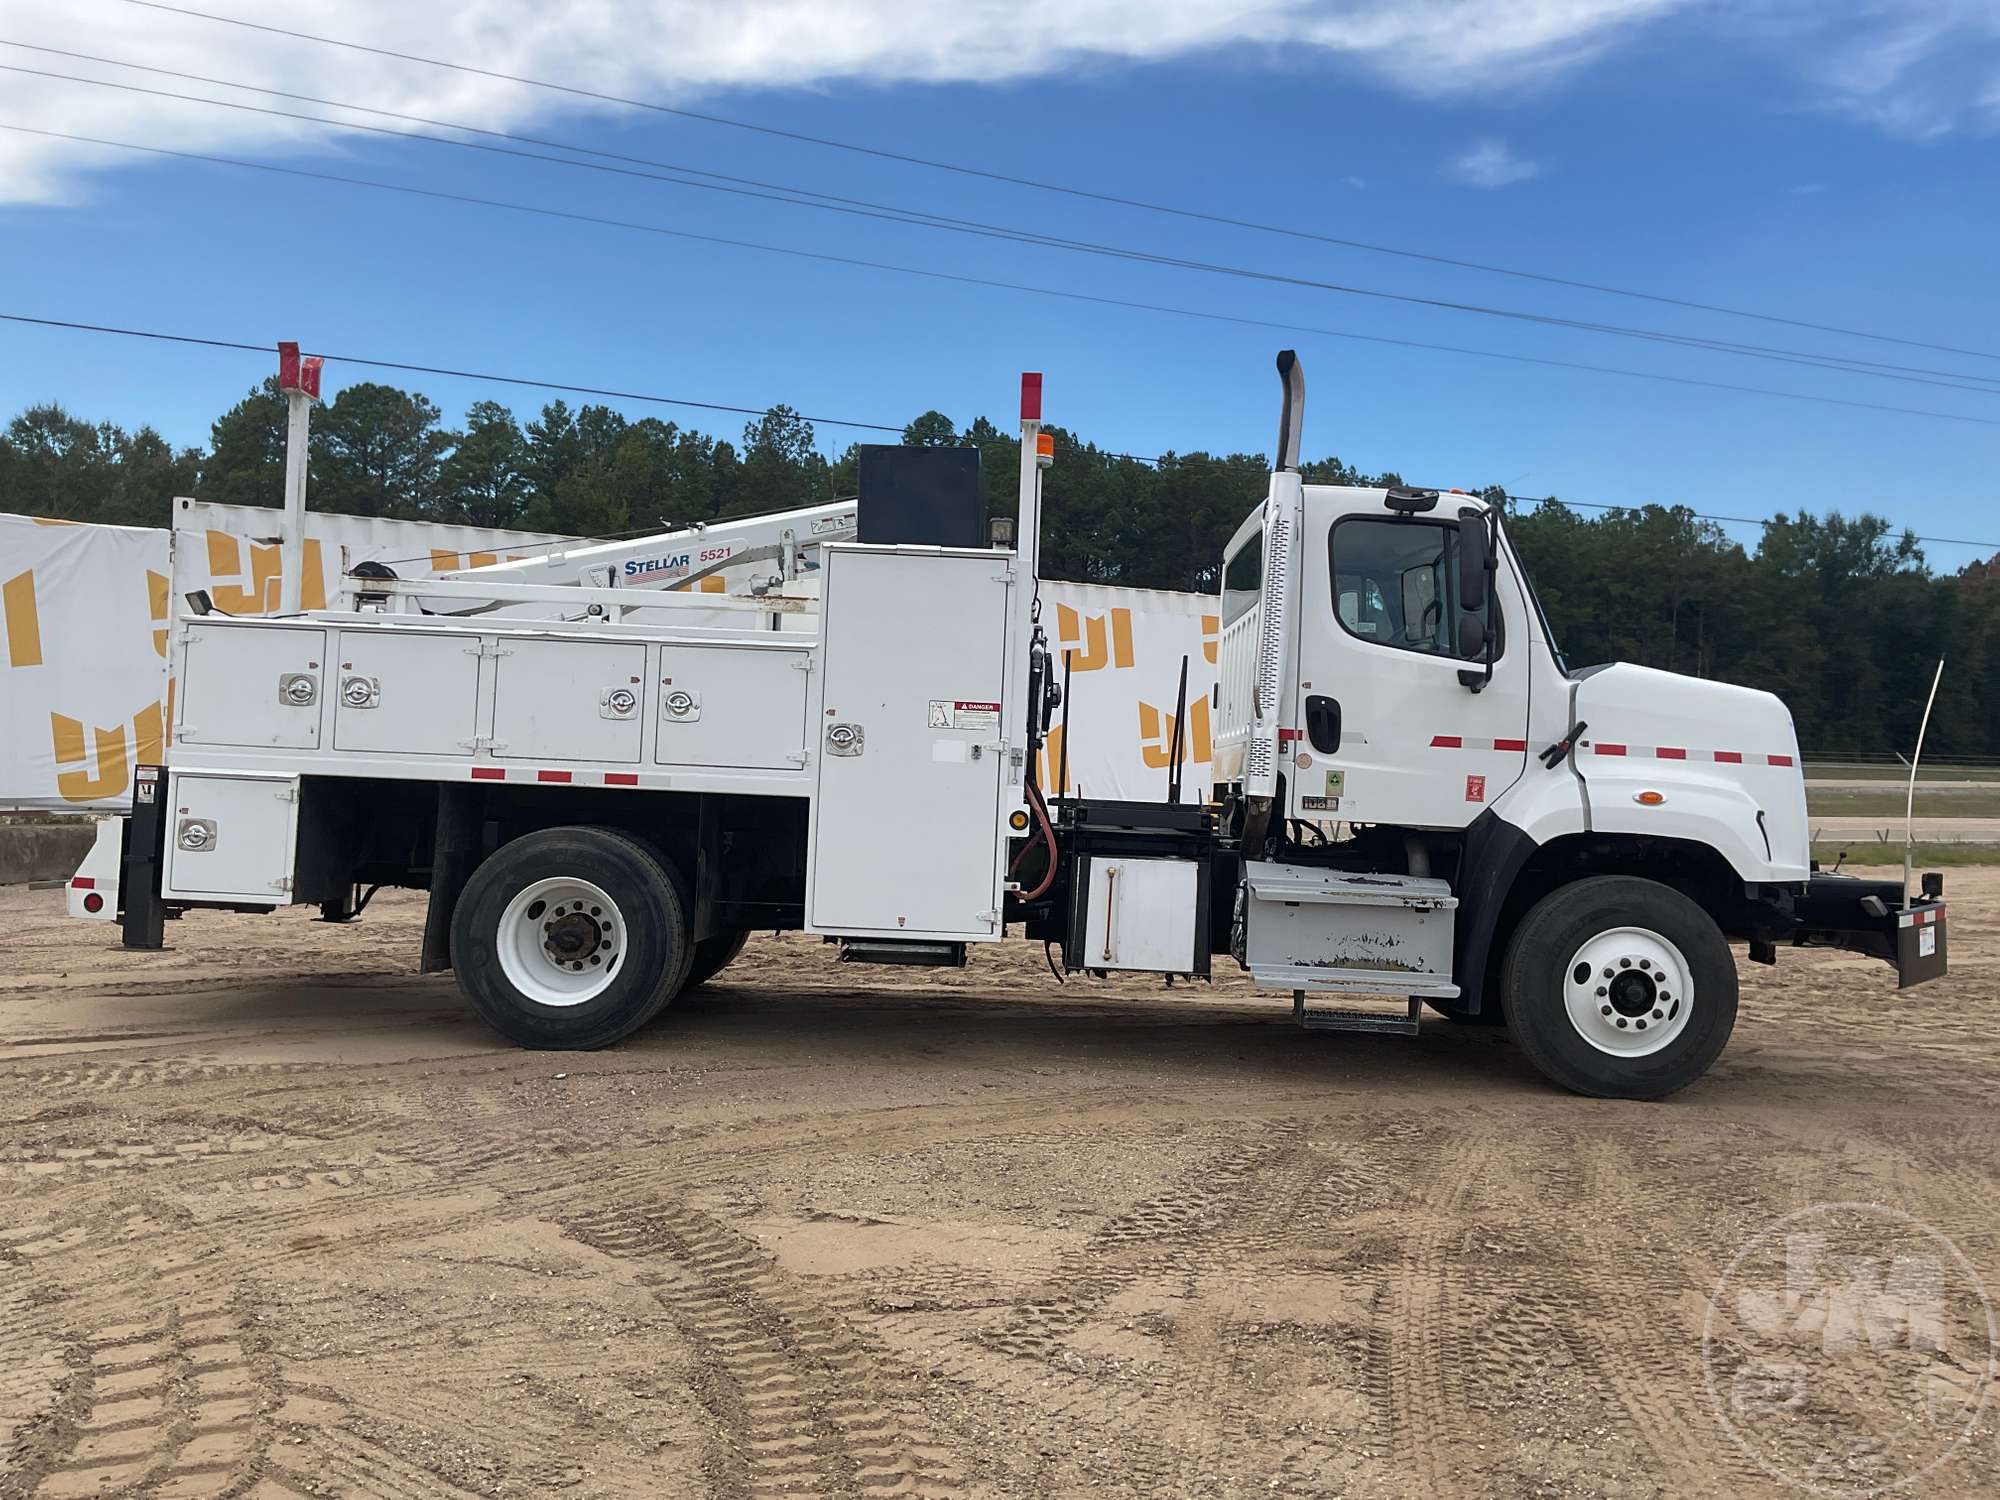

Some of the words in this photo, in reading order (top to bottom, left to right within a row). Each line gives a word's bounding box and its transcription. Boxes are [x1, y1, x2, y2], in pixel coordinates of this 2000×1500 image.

[624, 554, 690, 576] STELLAR
[699, 547, 731, 562] 5521
[968, 703, 994, 711] DANGER
